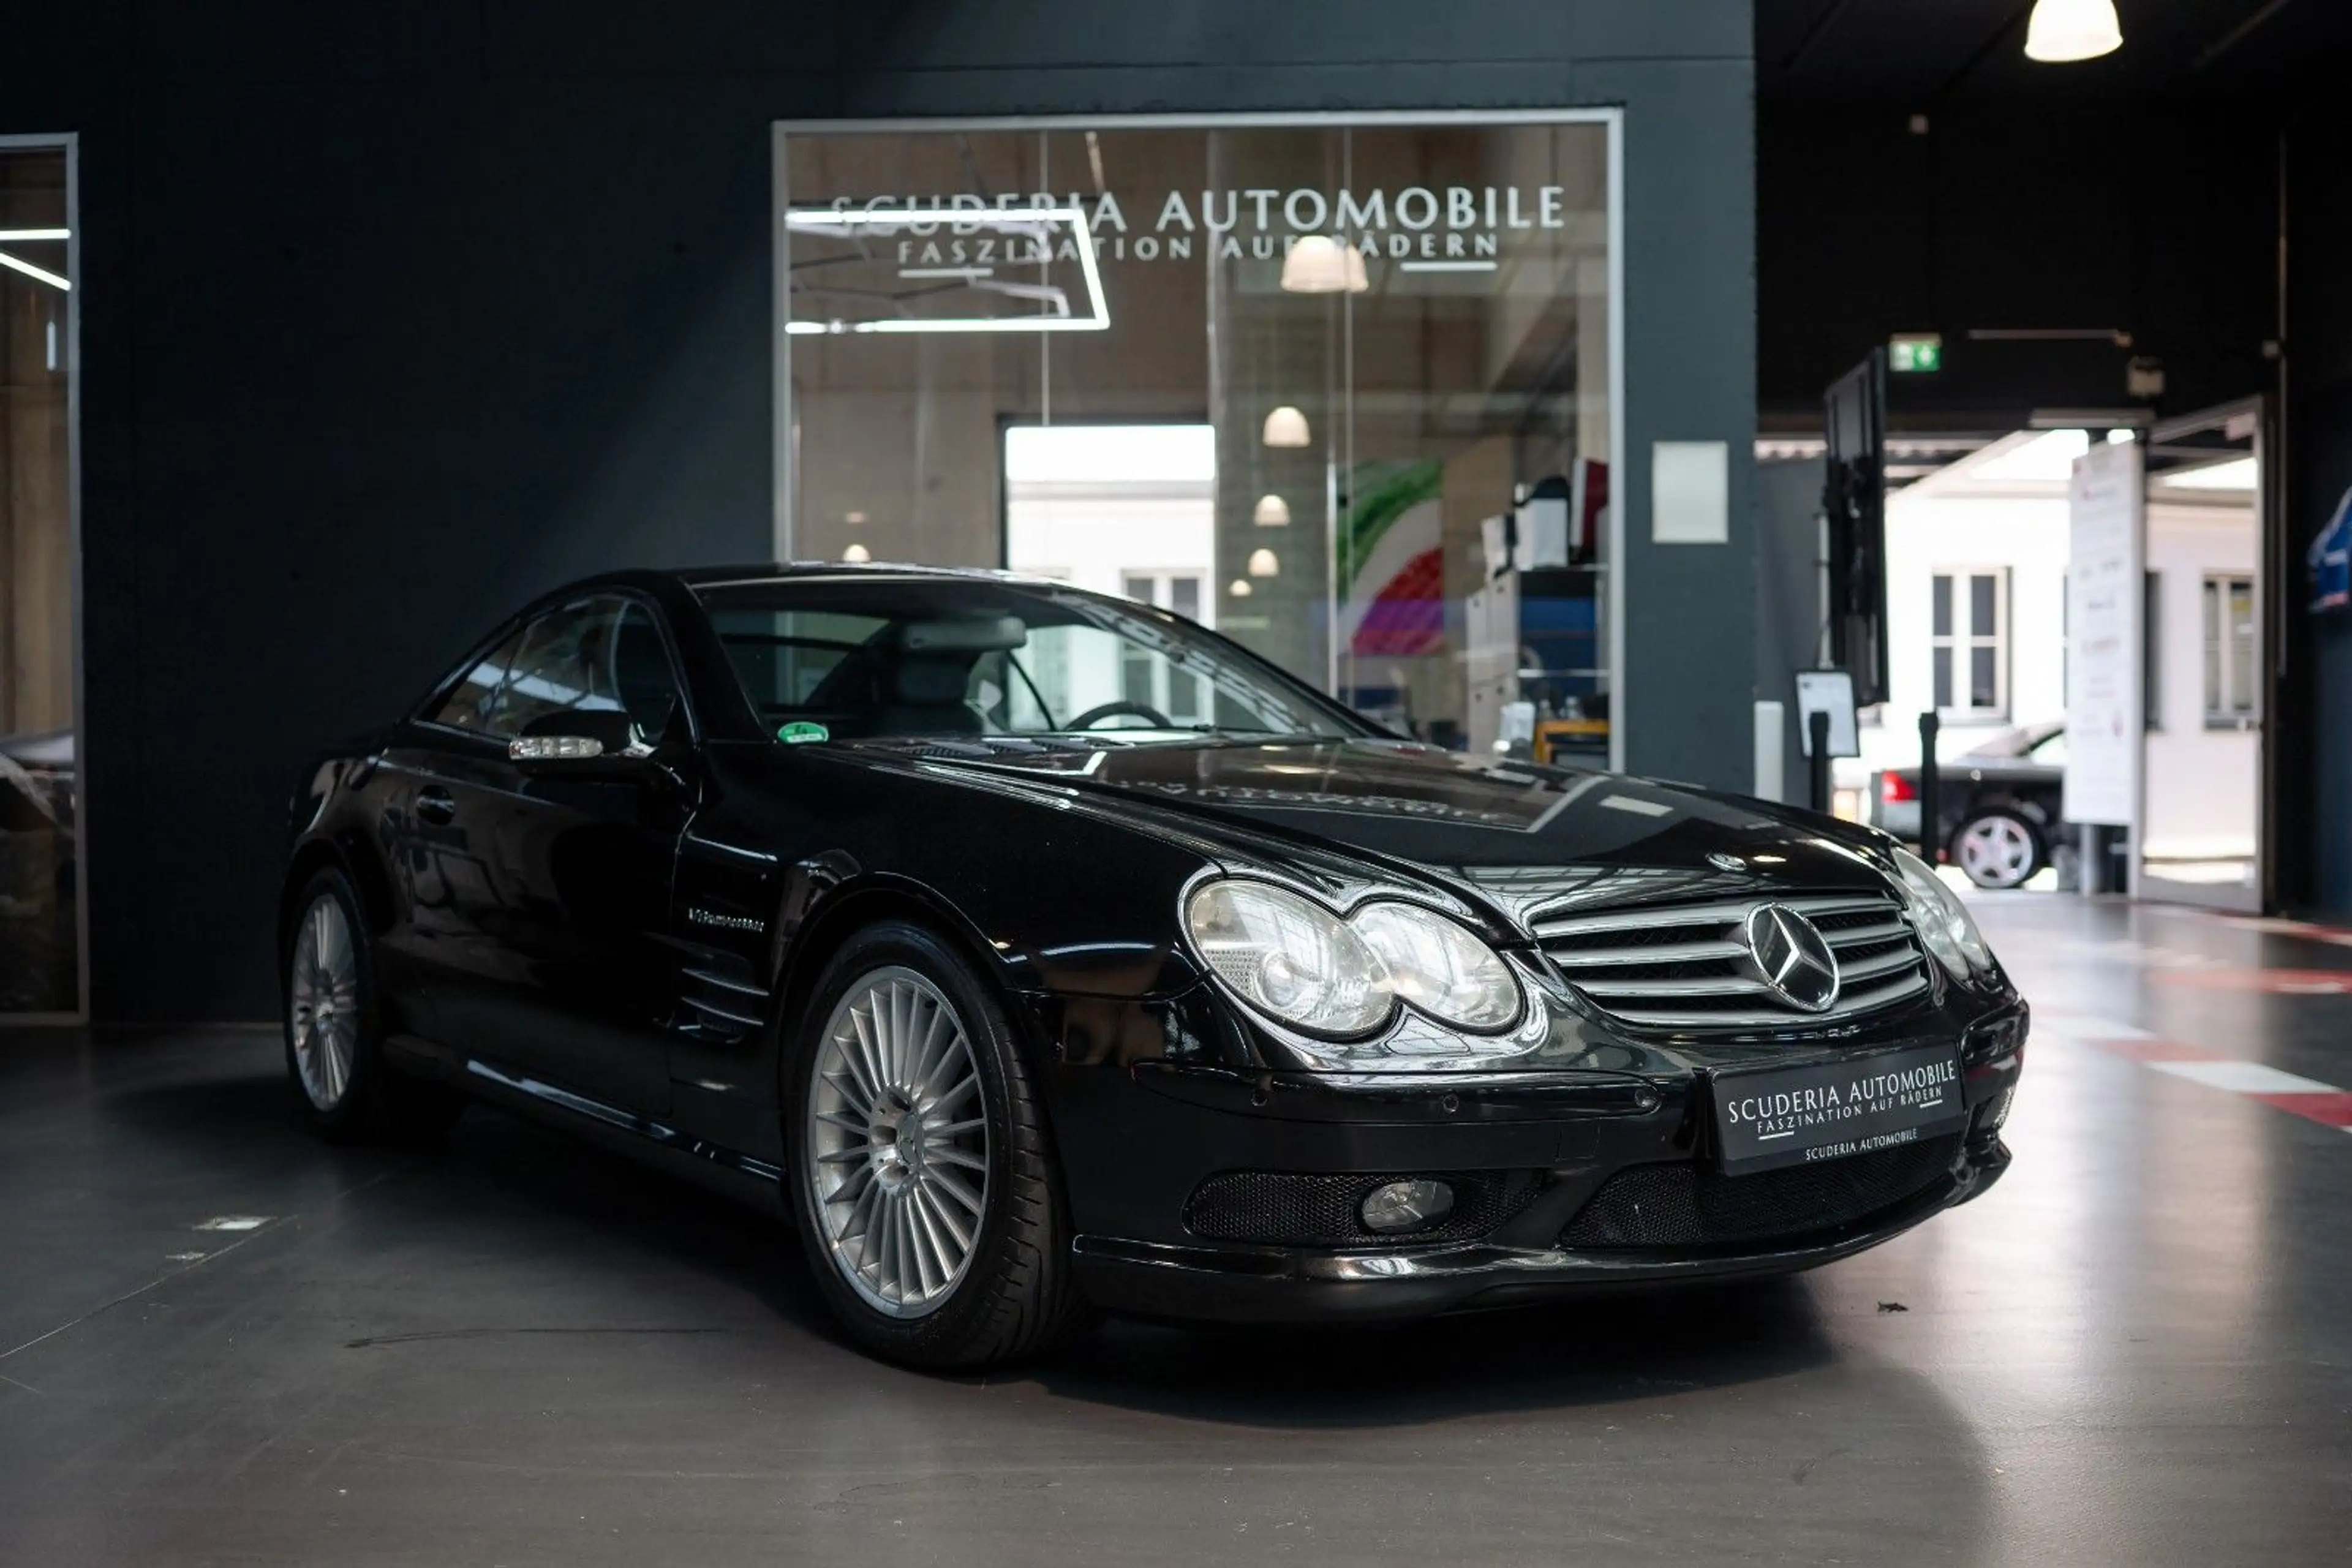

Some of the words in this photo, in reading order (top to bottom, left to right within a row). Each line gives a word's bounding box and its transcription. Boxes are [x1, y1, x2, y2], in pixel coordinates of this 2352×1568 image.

[1156, 186, 1565, 232] AUTOMOBILE
[898, 236, 1192, 263] FASZINATION
[1728, 1085, 1840, 1124] SCUDERIA
[1849, 1060, 1956, 1103] AUTOMOBILE
[1757, 1103, 1862, 1134] FASZINATION
[1870, 1097, 1893, 1114] AUF
[1900, 1085, 1942, 1106] RÄDERN
[1806, 1142, 1856, 1161] SCUDERIA
[1860, 1128, 1918, 1152] AUTOMOBILE
